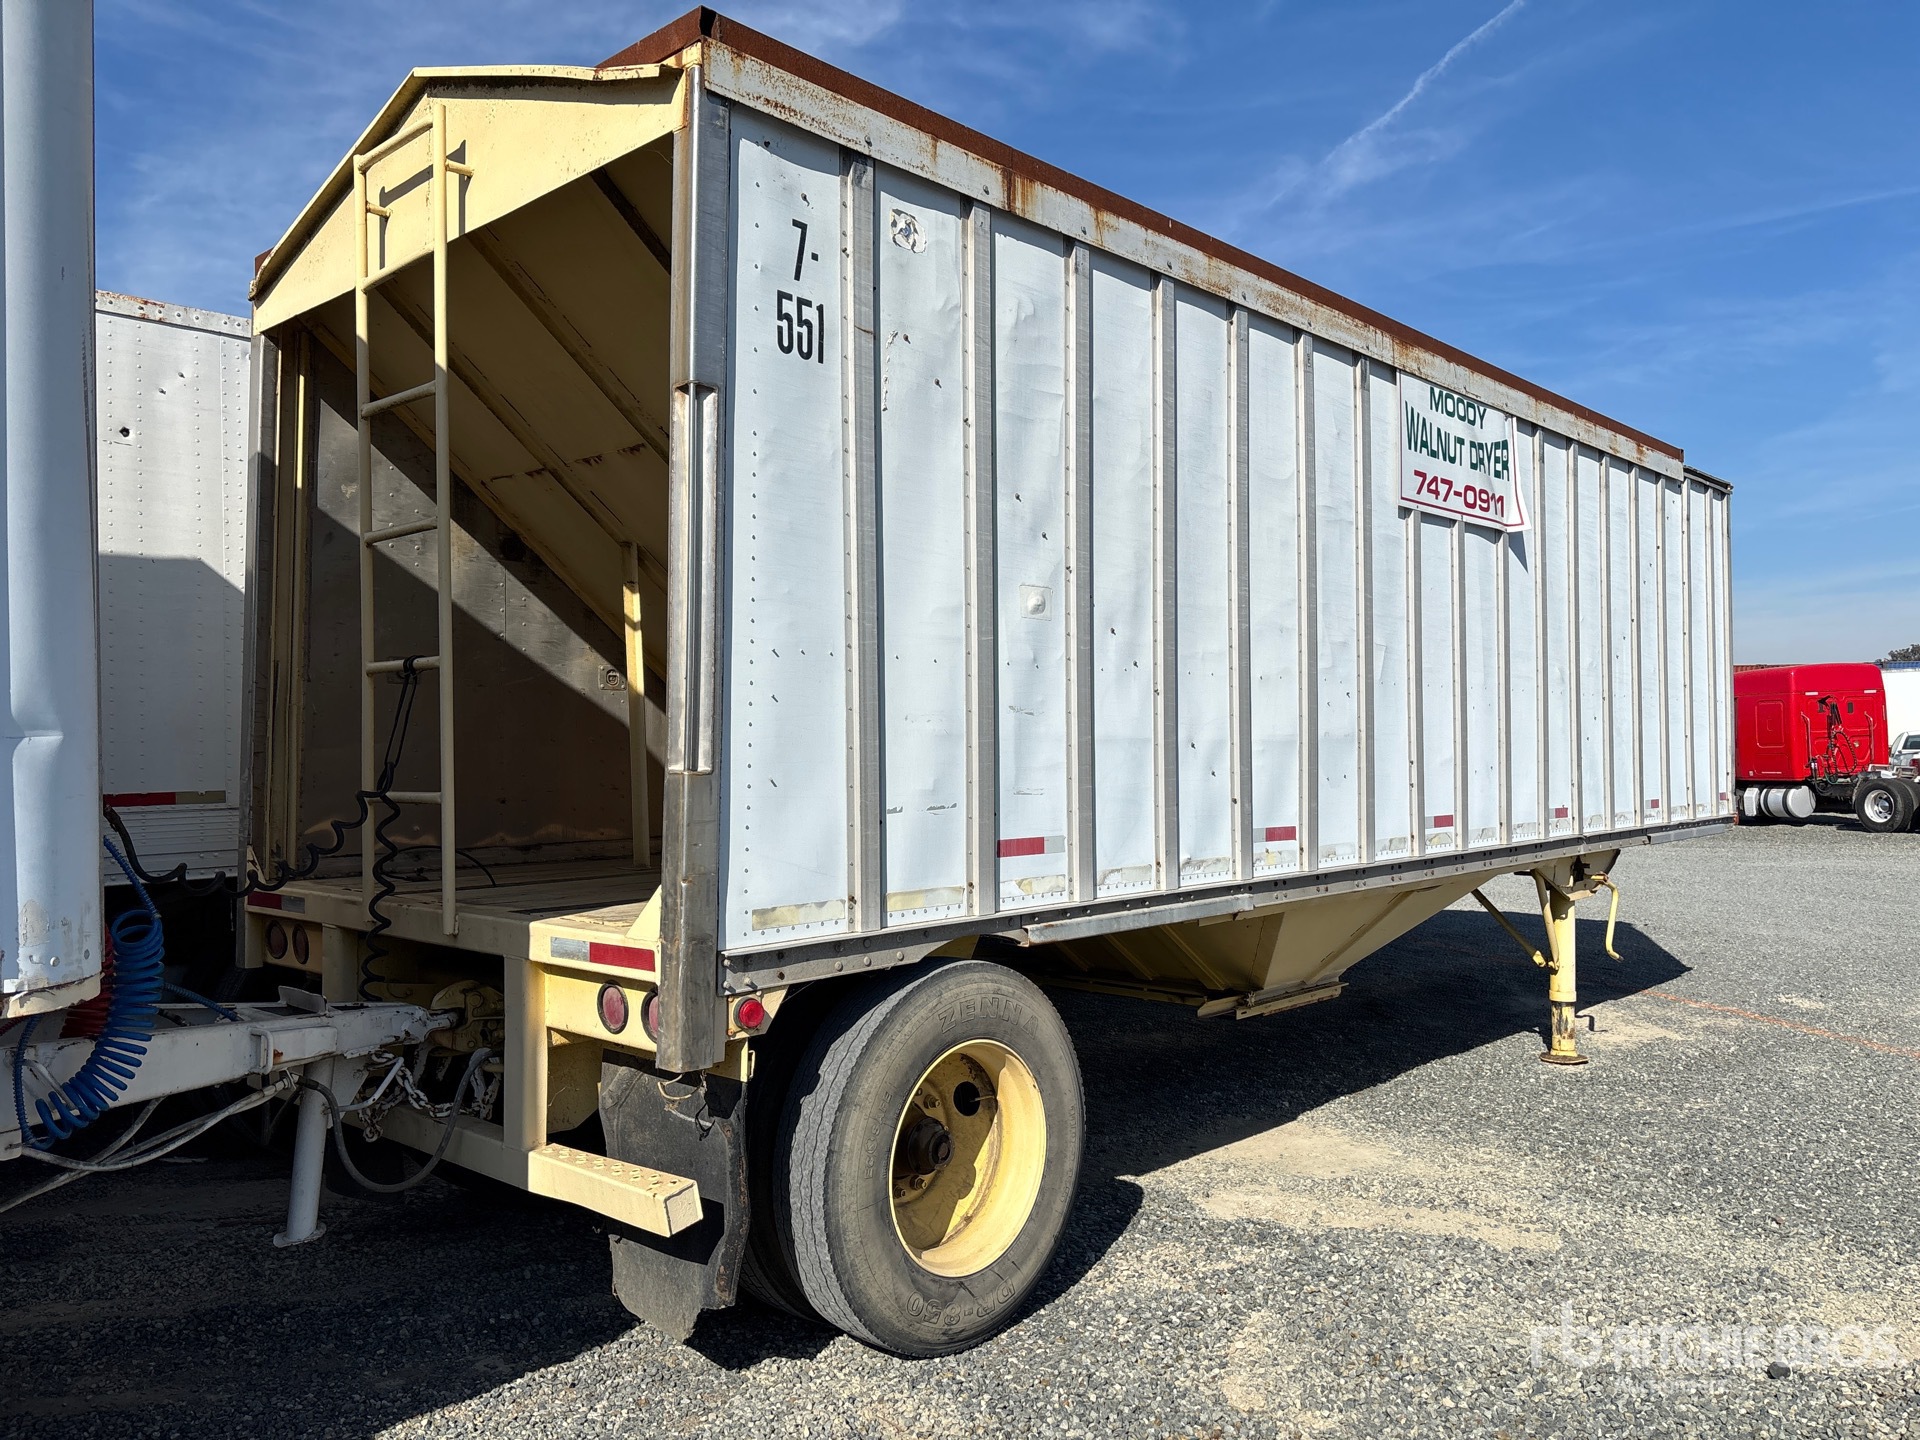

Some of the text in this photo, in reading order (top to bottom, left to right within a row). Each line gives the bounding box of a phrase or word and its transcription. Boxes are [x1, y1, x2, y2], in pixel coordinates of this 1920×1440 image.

[776, 289, 824, 364] 551
[1430, 387, 1487, 429] MOODY
[1405, 401, 1510, 481] WALNUT DRYER
[1414, 469, 1504, 517] 747-0911
